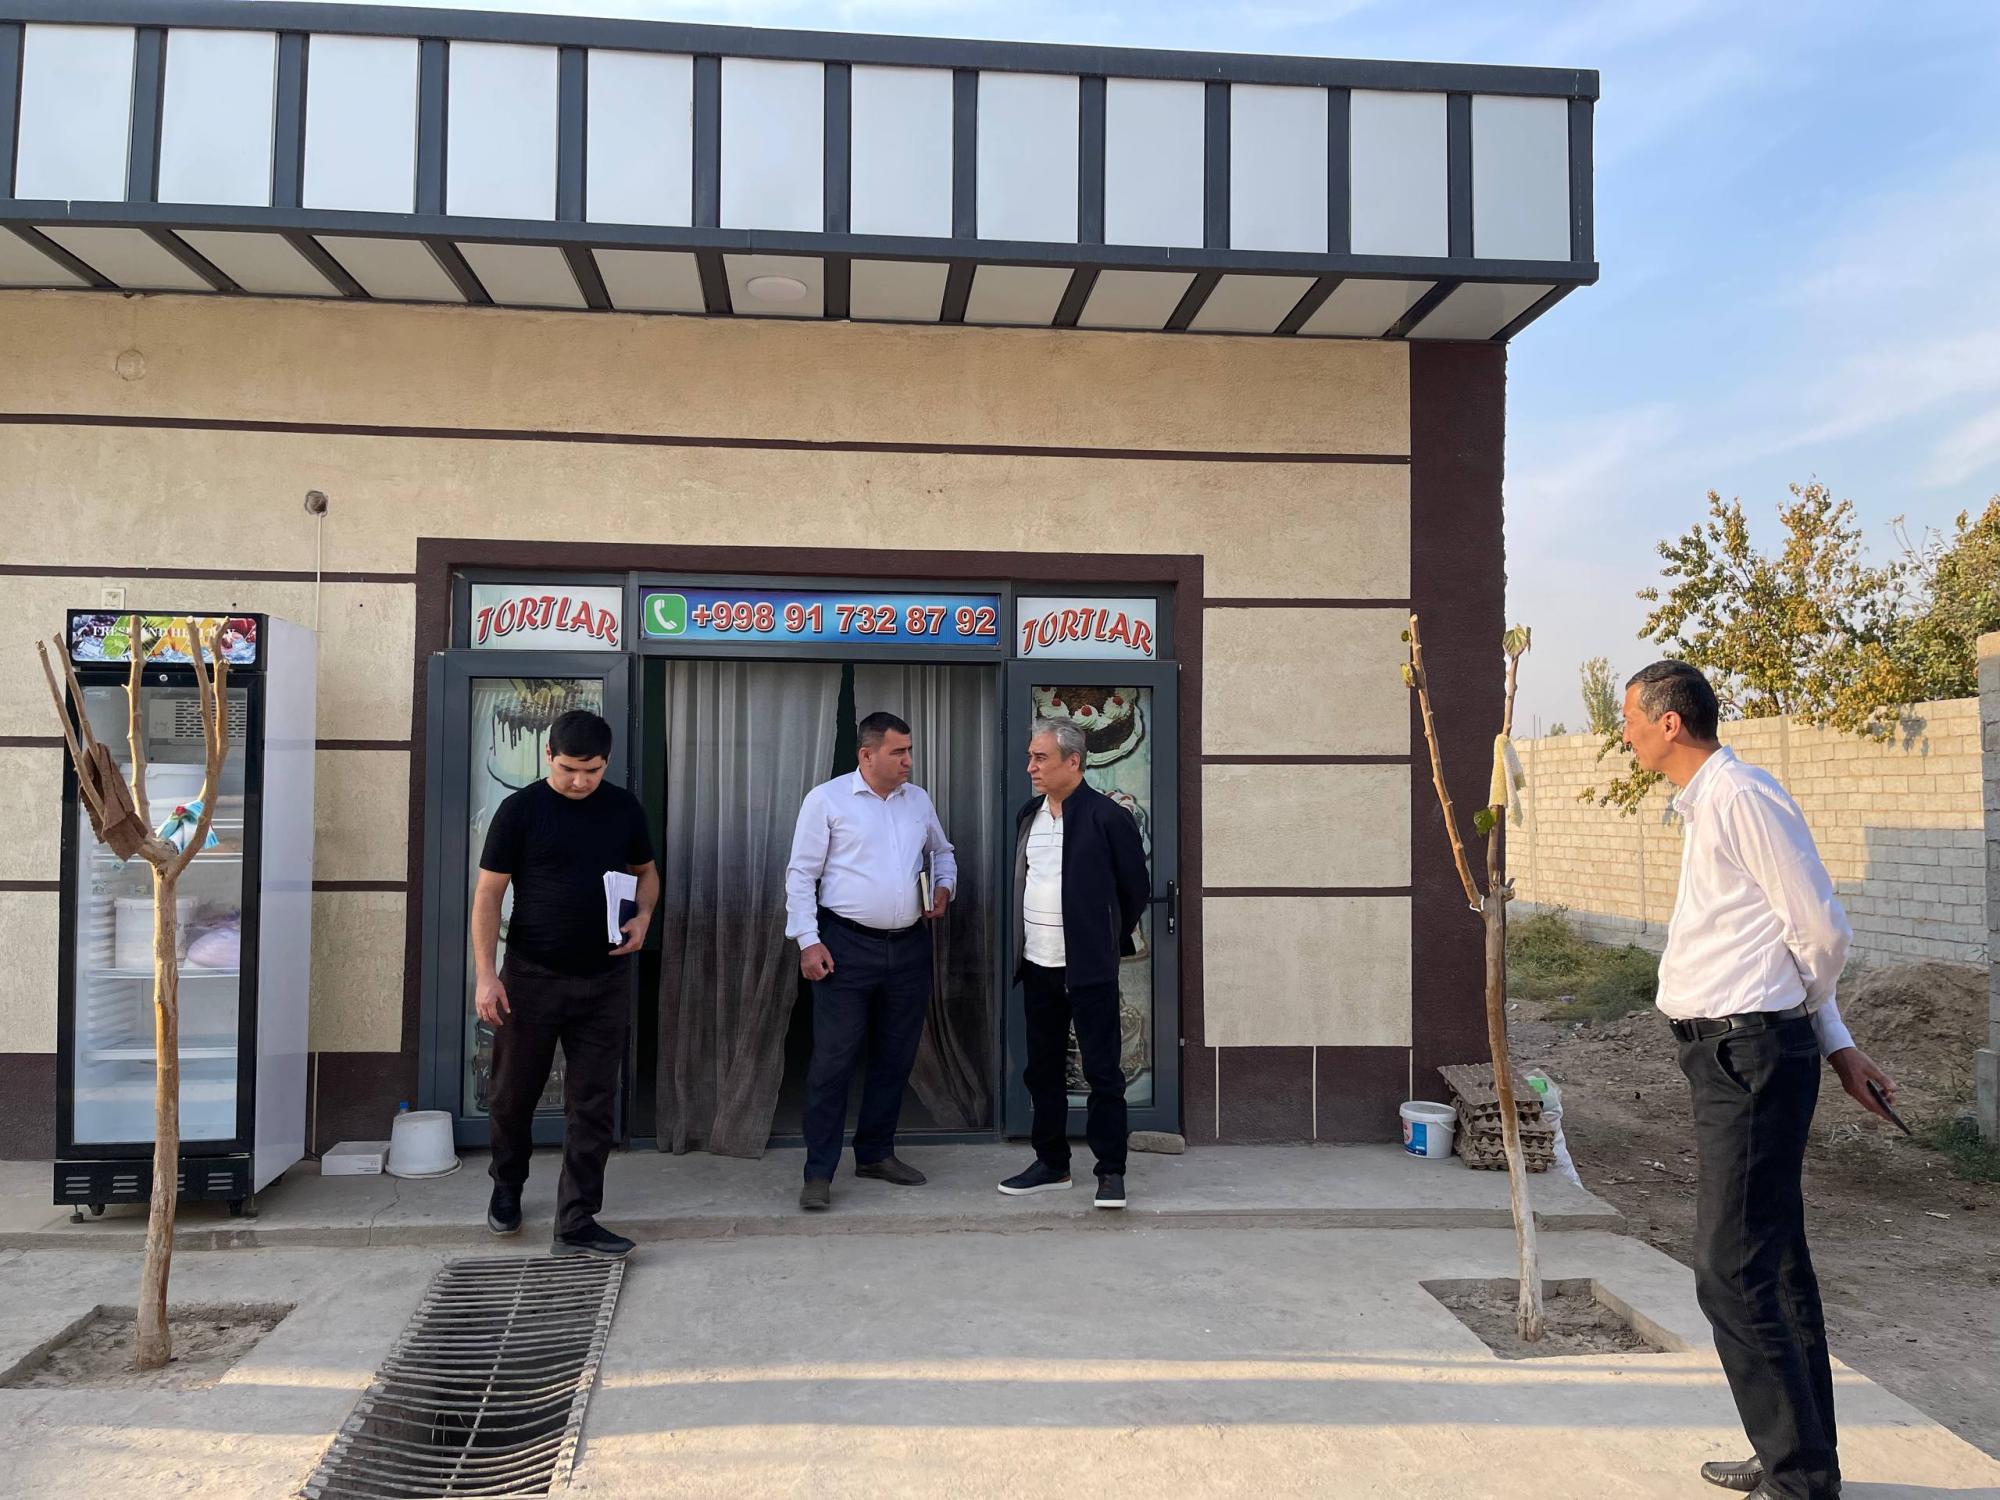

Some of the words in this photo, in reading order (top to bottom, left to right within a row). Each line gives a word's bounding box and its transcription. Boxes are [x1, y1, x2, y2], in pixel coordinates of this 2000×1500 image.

[477, 594, 619, 645] TORTLAR
[692, 601, 775, 632] +998
[784, 602, 823, 632] 91
[836, 604, 897, 634] 732
[906, 605, 947, 634] 87
[955, 606, 996, 635] 92
[1023, 606, 1153, 656] TORTLAR
